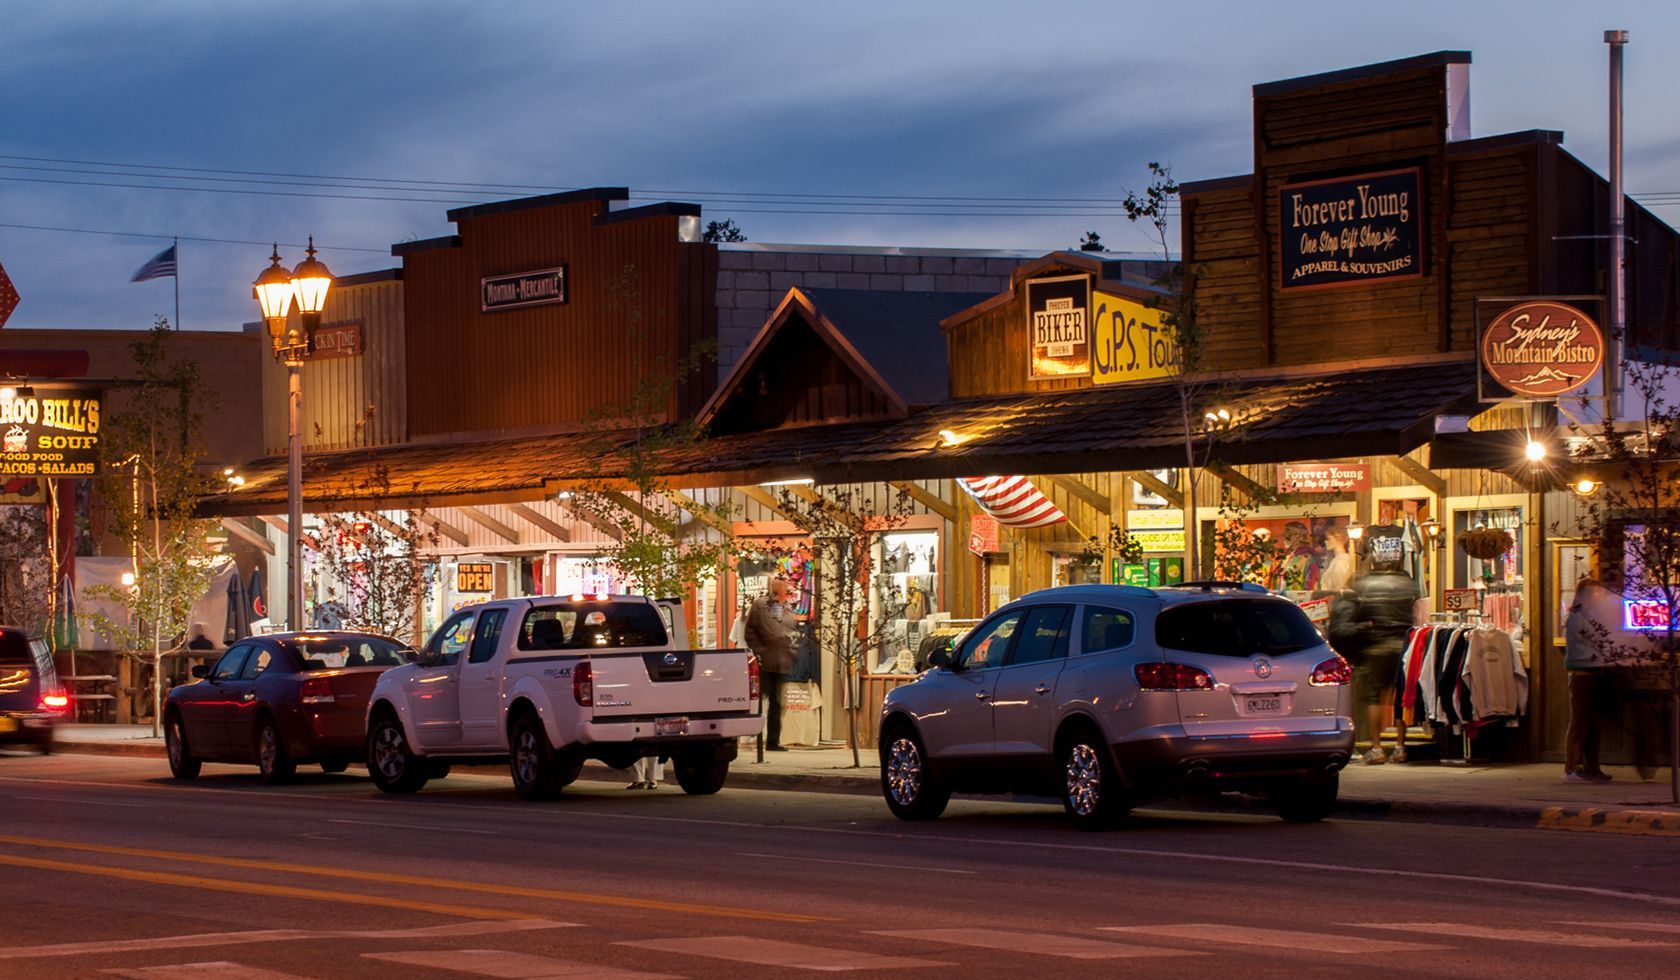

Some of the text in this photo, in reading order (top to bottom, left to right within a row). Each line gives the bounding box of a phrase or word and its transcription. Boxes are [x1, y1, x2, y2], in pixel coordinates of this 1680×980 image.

[1292, 185, 1409, 227] Forever Young
[1300, 224, 1383, 258] One Stop Gift Shop
[1292, 255, 1412, 280] APPAREL & SOUVENIRS
[1037, 312, 1083, 344] BIKER
[1094, 303, 1139, 375] G.P.S.
[1506, 314, 1580, 358] Sydney's
[1492, 341, 1595, 364] Mountain Bistro
[42, 399, 99, 433] BILL'S
[33, 453, 63, 461] FOOD
[42, 463, 95, 474] SALADS
[1285, 467, 1364, 481] Forever Young
[1376, 538, 1401, 549] TIGER
[459, 564, 471, 572] YES
[458, 573, 493, 590] OPEN
[1447, 596, 1462, 608] $9
